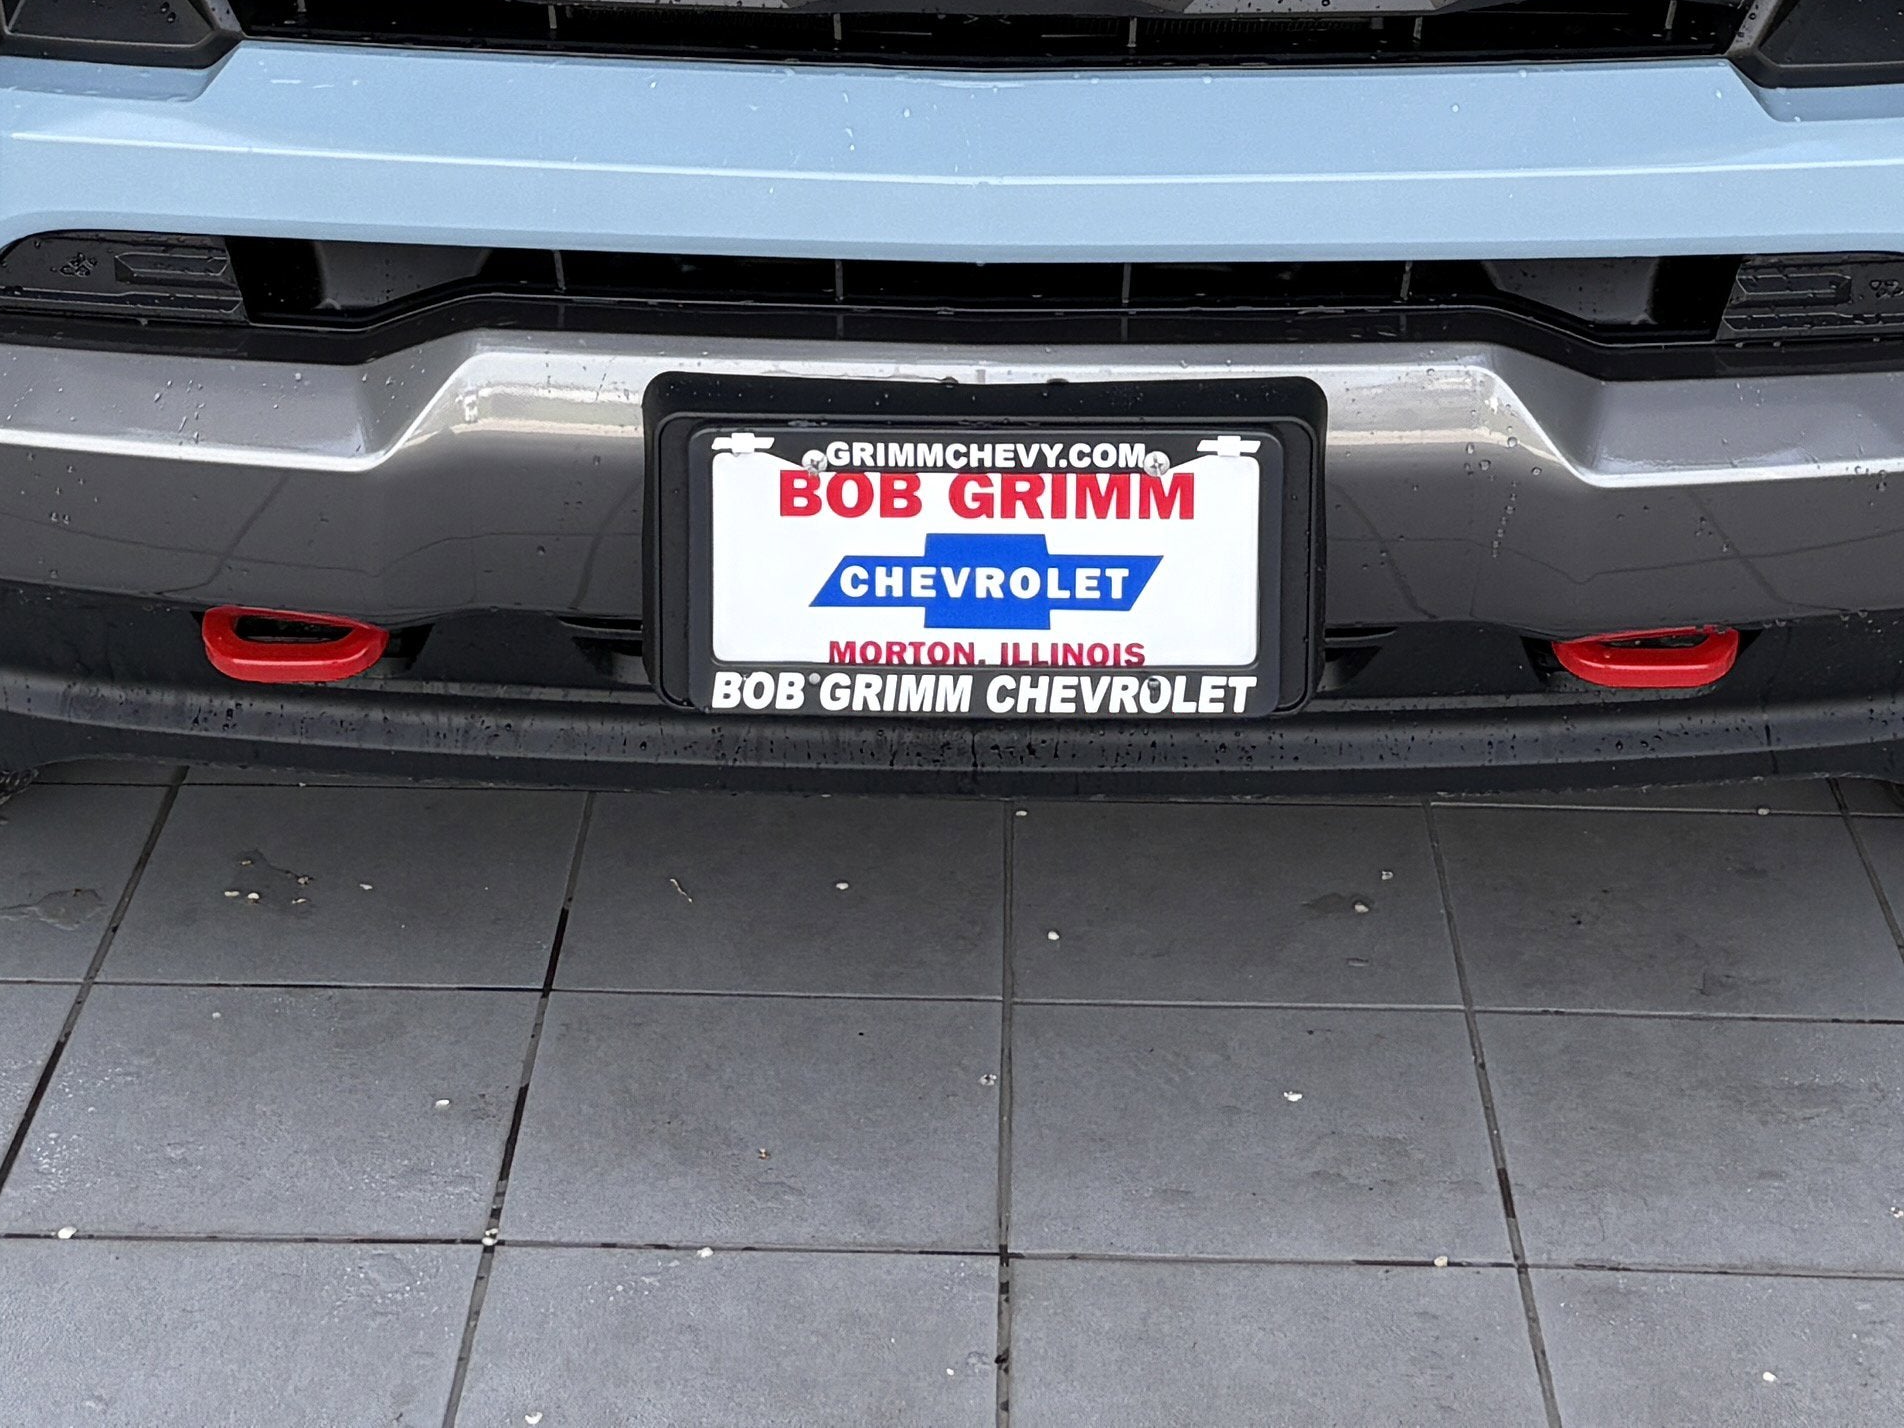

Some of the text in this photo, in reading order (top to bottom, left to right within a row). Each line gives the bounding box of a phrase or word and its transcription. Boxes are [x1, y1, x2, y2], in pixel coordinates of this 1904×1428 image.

[826, 441, 1147, 471] GRIMMCHEVY.COM
[779, 471, 1194, 520] BOB GRIMM
[840, 564, 1131, 601] CHEVROLET
[1001, 641, 1147, 666] ILLINOIS
[712, 671, 1258, 715] BOB GRIMM CHEVROLET
